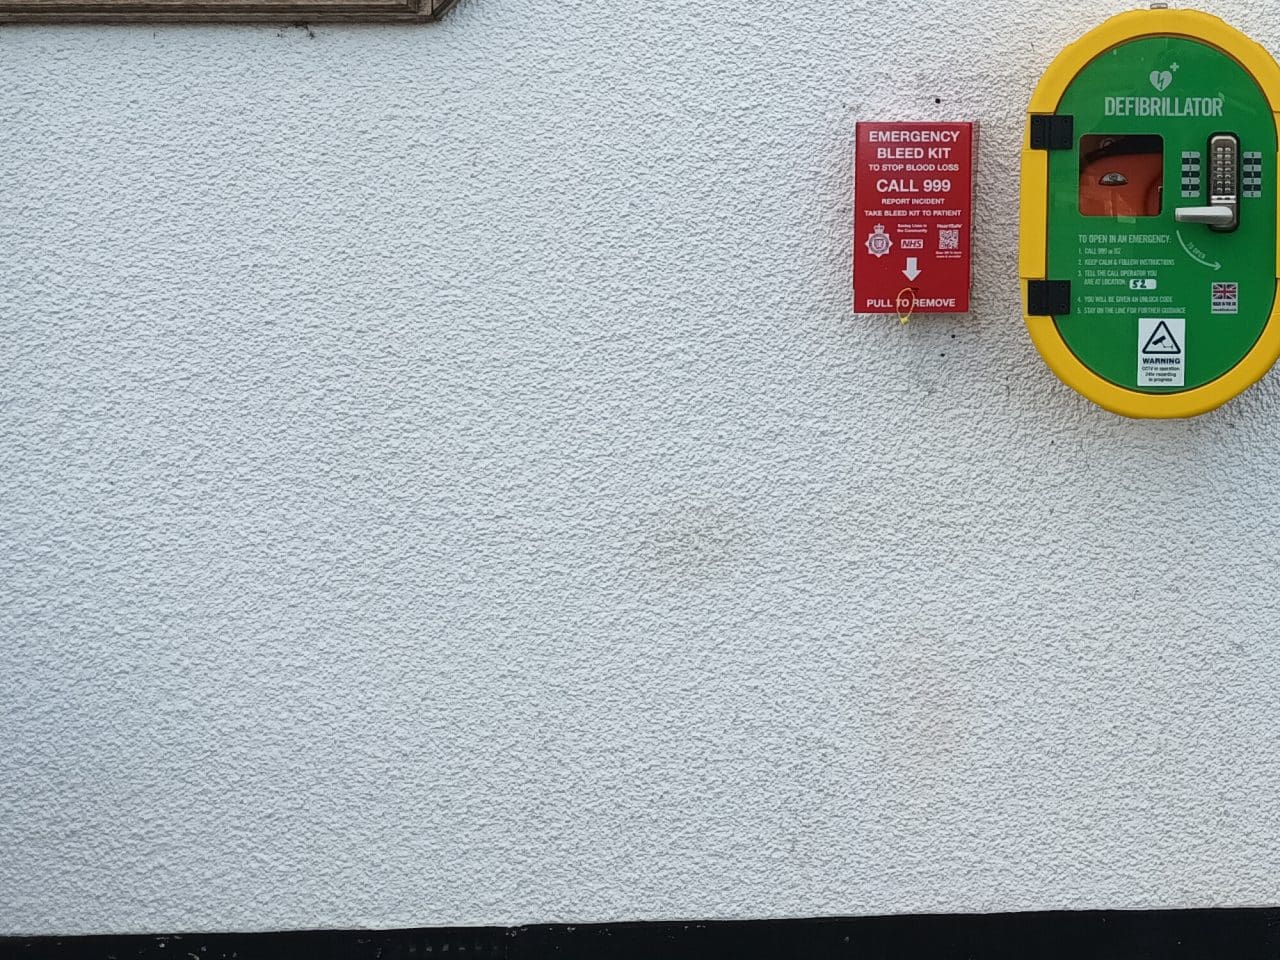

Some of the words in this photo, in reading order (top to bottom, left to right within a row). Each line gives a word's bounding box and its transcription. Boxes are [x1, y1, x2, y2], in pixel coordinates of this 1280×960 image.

[1104, 96, 1223, 117] DEFIBRILLATOR
[869, 130, 960, 143] EMERGENCY
[877, 147, 924, 159] BLEED
[928, 147, 952, 159] KIT
[876, 179, 919, 193] CALL
[923, 179, 951, 193] 999
[901, 240, 922, 248] NHS
[1078, 234, 1088, 243] TO
[1089, 234, 1108, 243] OPEN
[1132, 280, 1147, 288] 52
[866, 299, 893, 308] PULL
[897, 298, 910, 307] TO
[913, 298, 956, 307] REMOVE
